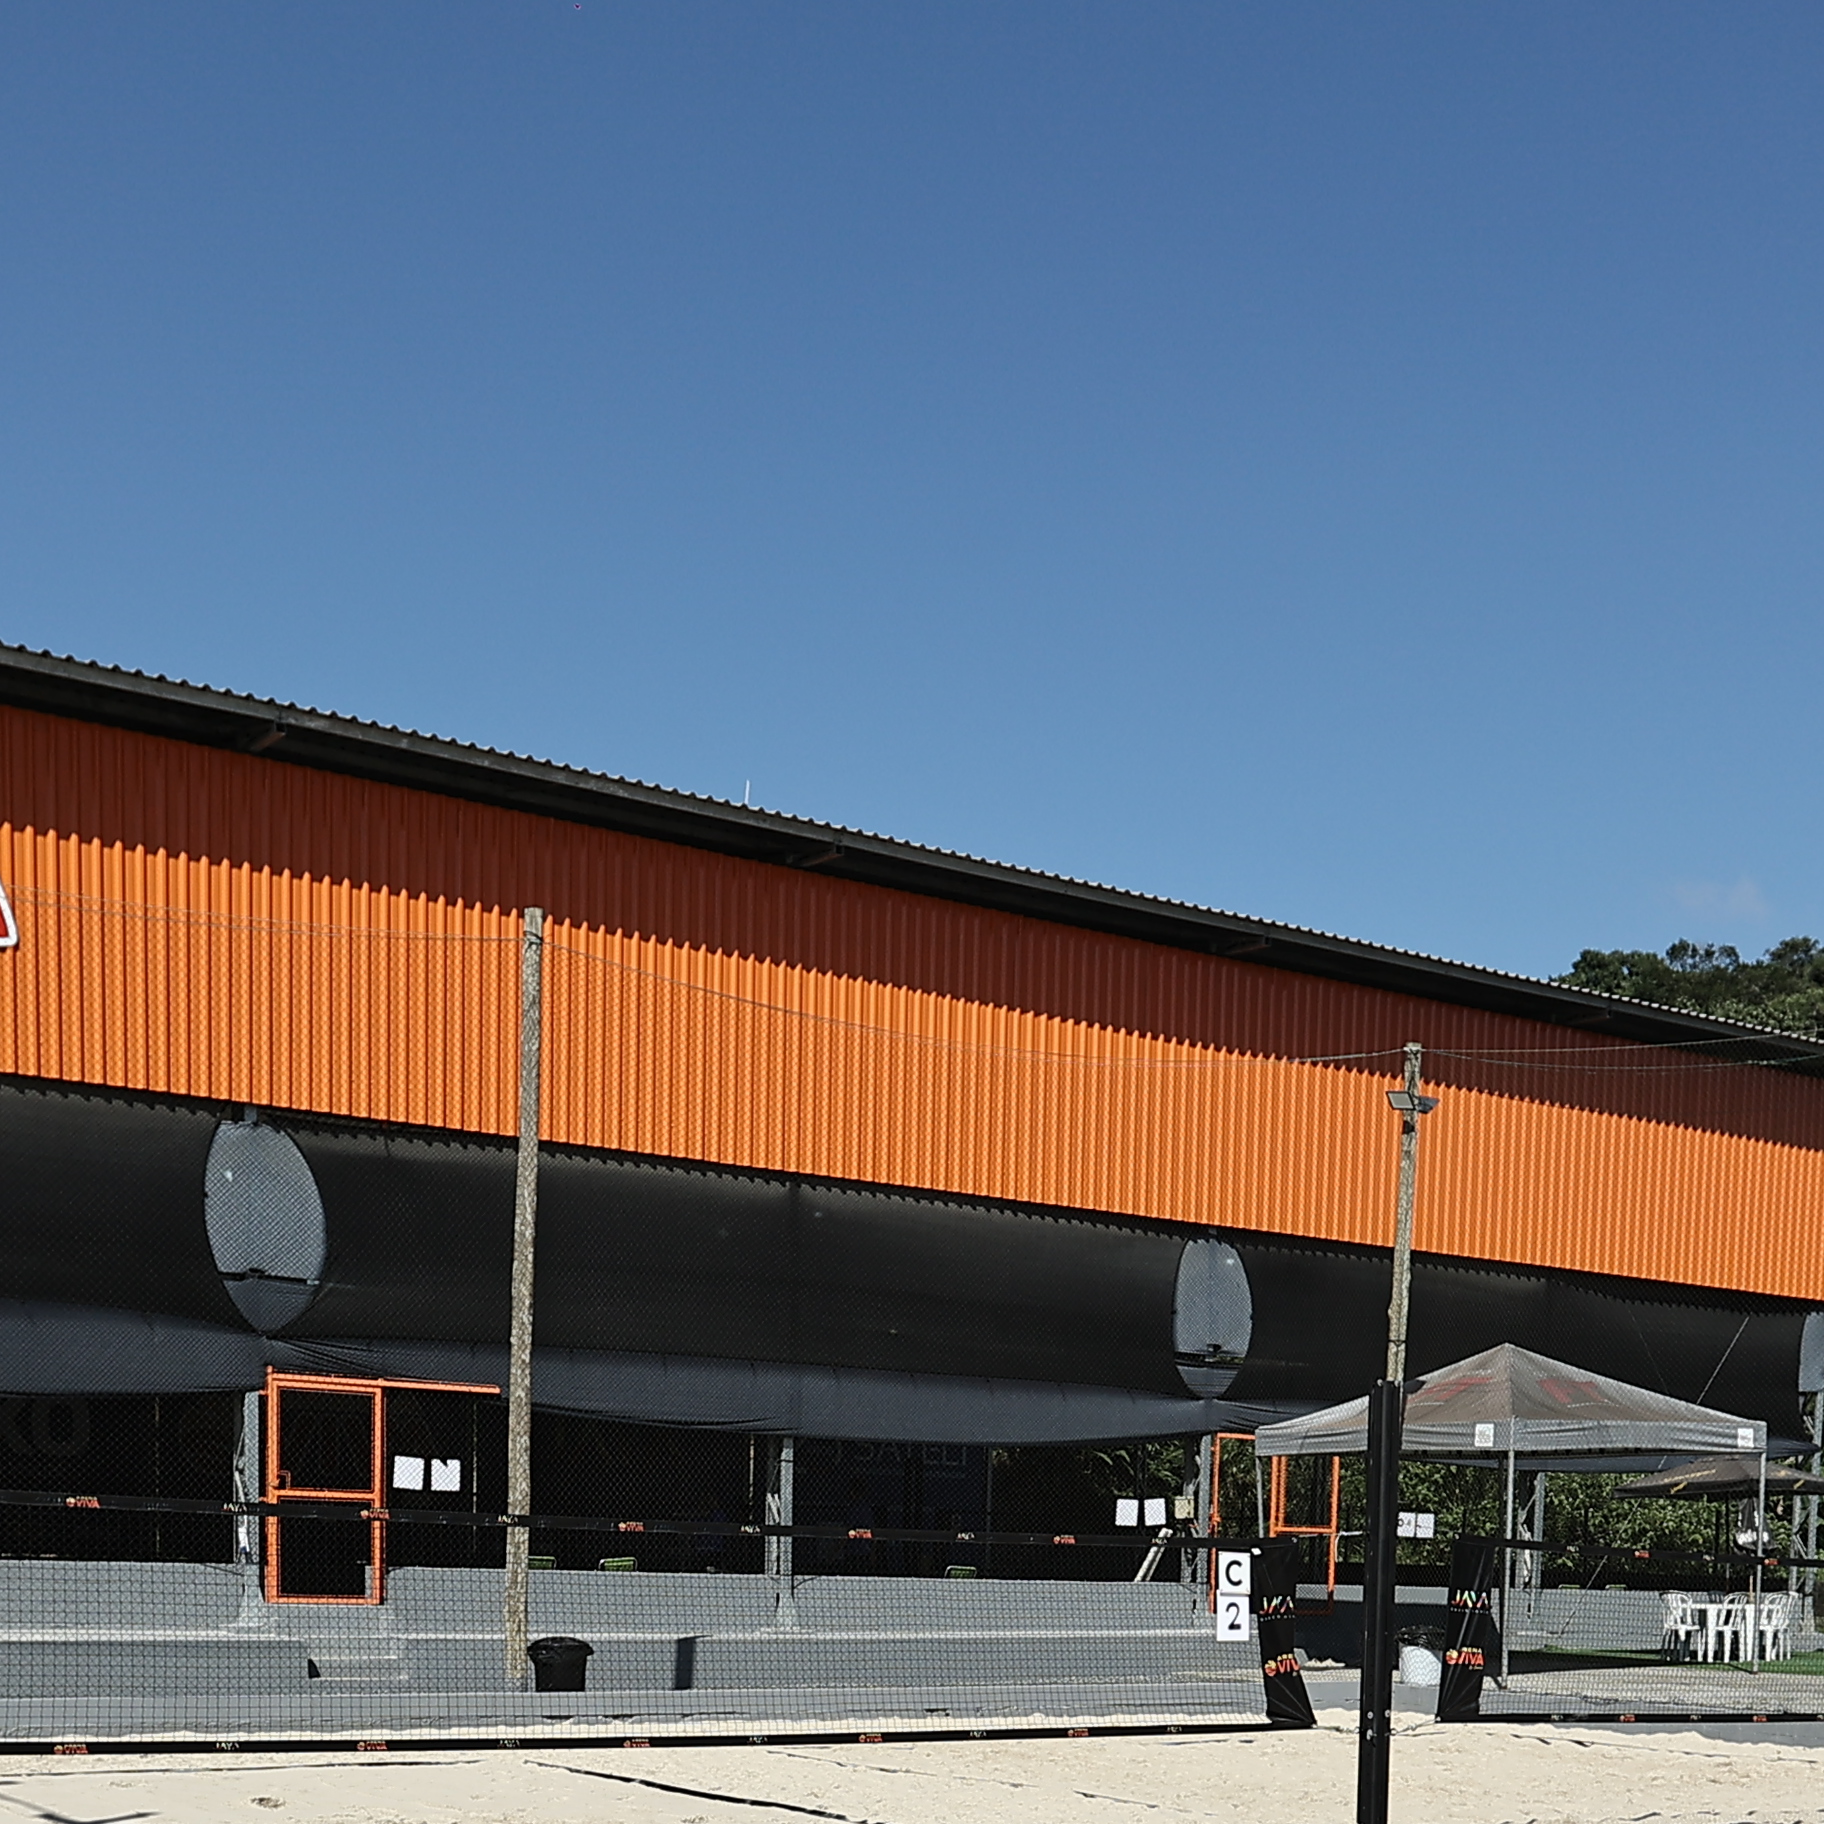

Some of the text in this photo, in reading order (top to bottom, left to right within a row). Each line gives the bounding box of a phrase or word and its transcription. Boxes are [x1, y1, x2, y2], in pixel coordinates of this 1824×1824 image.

[76, 1499, 100, 1508] VIVA
[1225, 1560, 1243, 1586] C
[1225, 1602, 1242, 1630] 2
